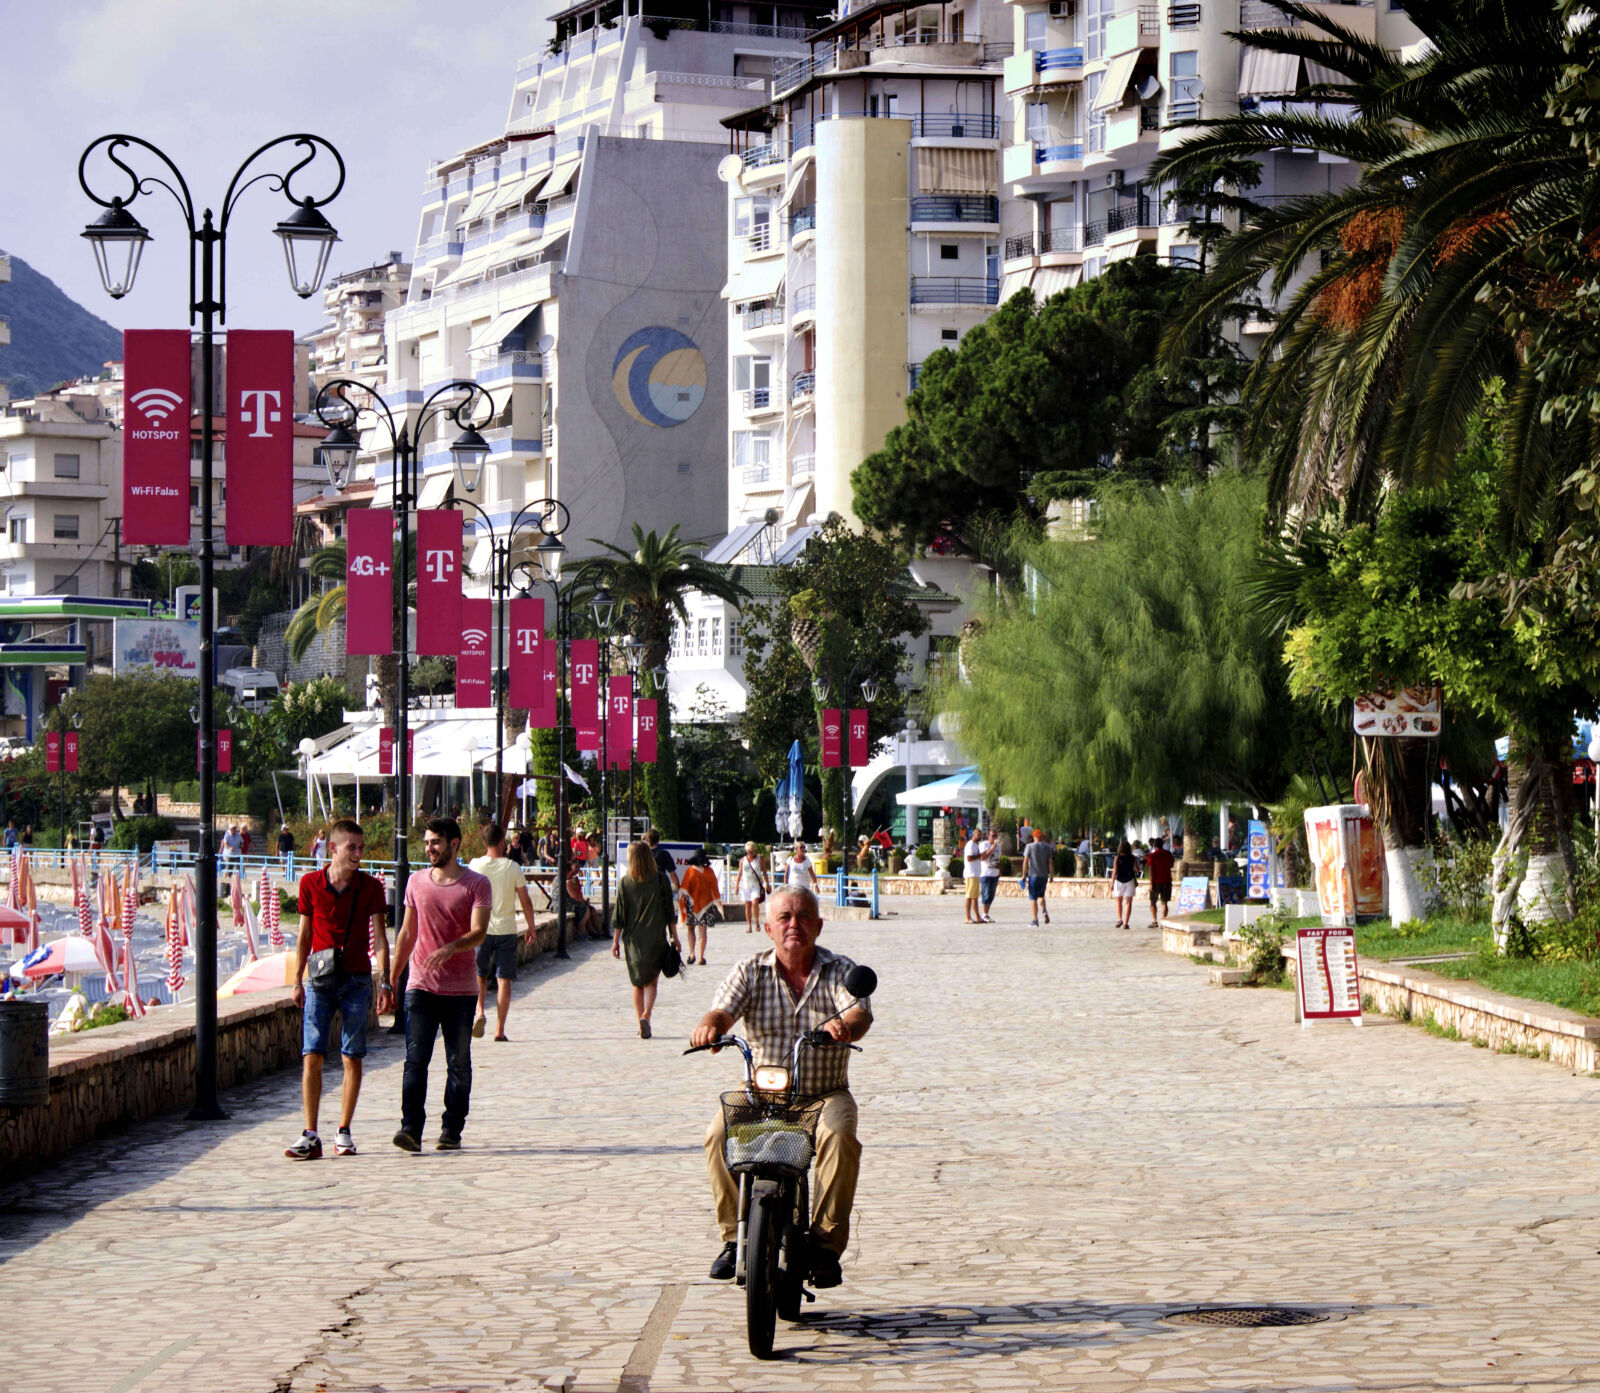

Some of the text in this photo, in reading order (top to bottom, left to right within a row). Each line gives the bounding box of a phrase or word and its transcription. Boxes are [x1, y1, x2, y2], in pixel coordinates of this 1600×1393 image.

[241, 390, 281, 438] T
[132, 430, 180, 440] HOTSPOT
[131, 486, 179, 496] Wi-Fi Falas
[350, 555, 390, 577] 4G+
[426, 550, 454, 582] T
[517, 629, 538, 654] T
[576, 664, 593, 684] T
[614, 697, 628, 714] T
[641, 716, 654, 731] T
[853, 725, 865, 739] T
